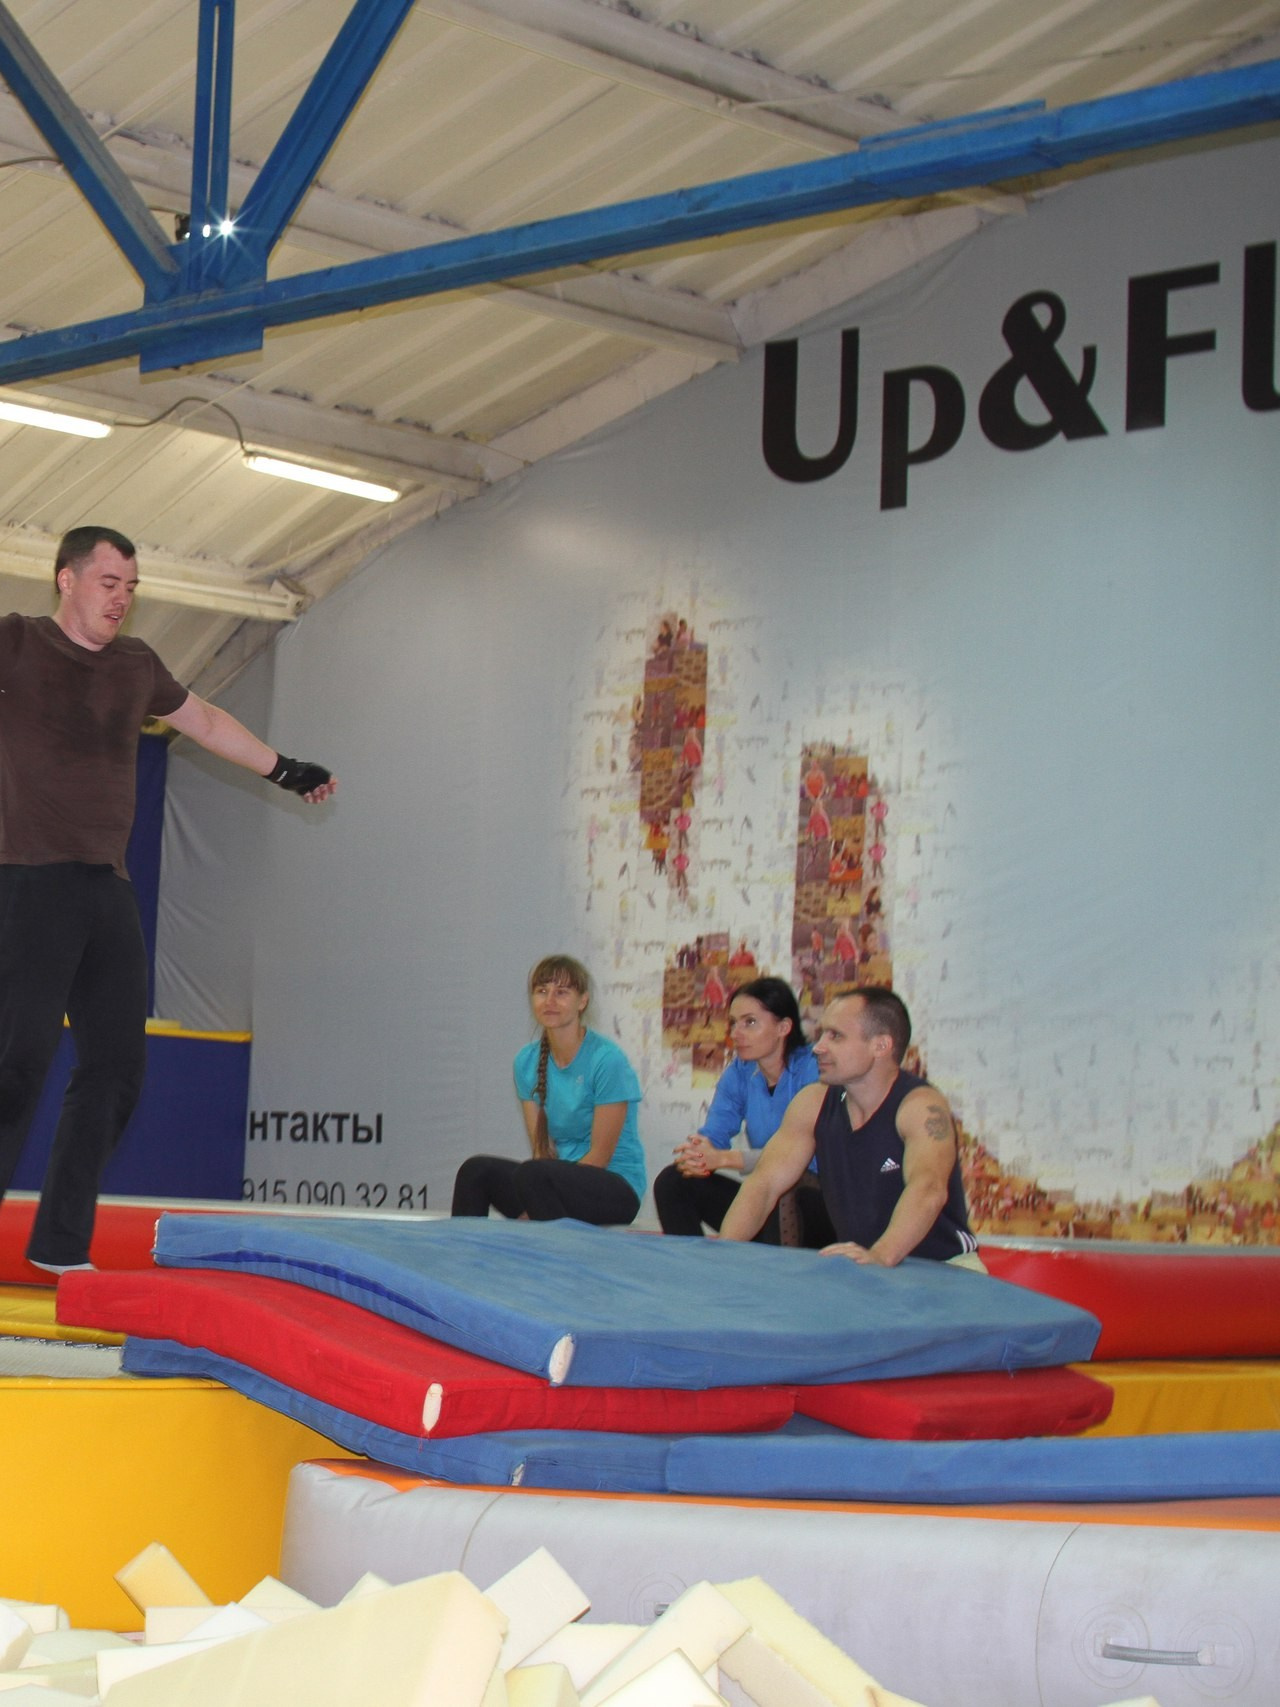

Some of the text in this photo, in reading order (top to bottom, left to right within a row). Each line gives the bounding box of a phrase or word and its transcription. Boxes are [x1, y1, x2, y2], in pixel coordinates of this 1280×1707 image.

[243, 1178, 287, 1204] 915
[297, 1181, 346, 1207] 090
[398, 1183, 428, 1211] 81
